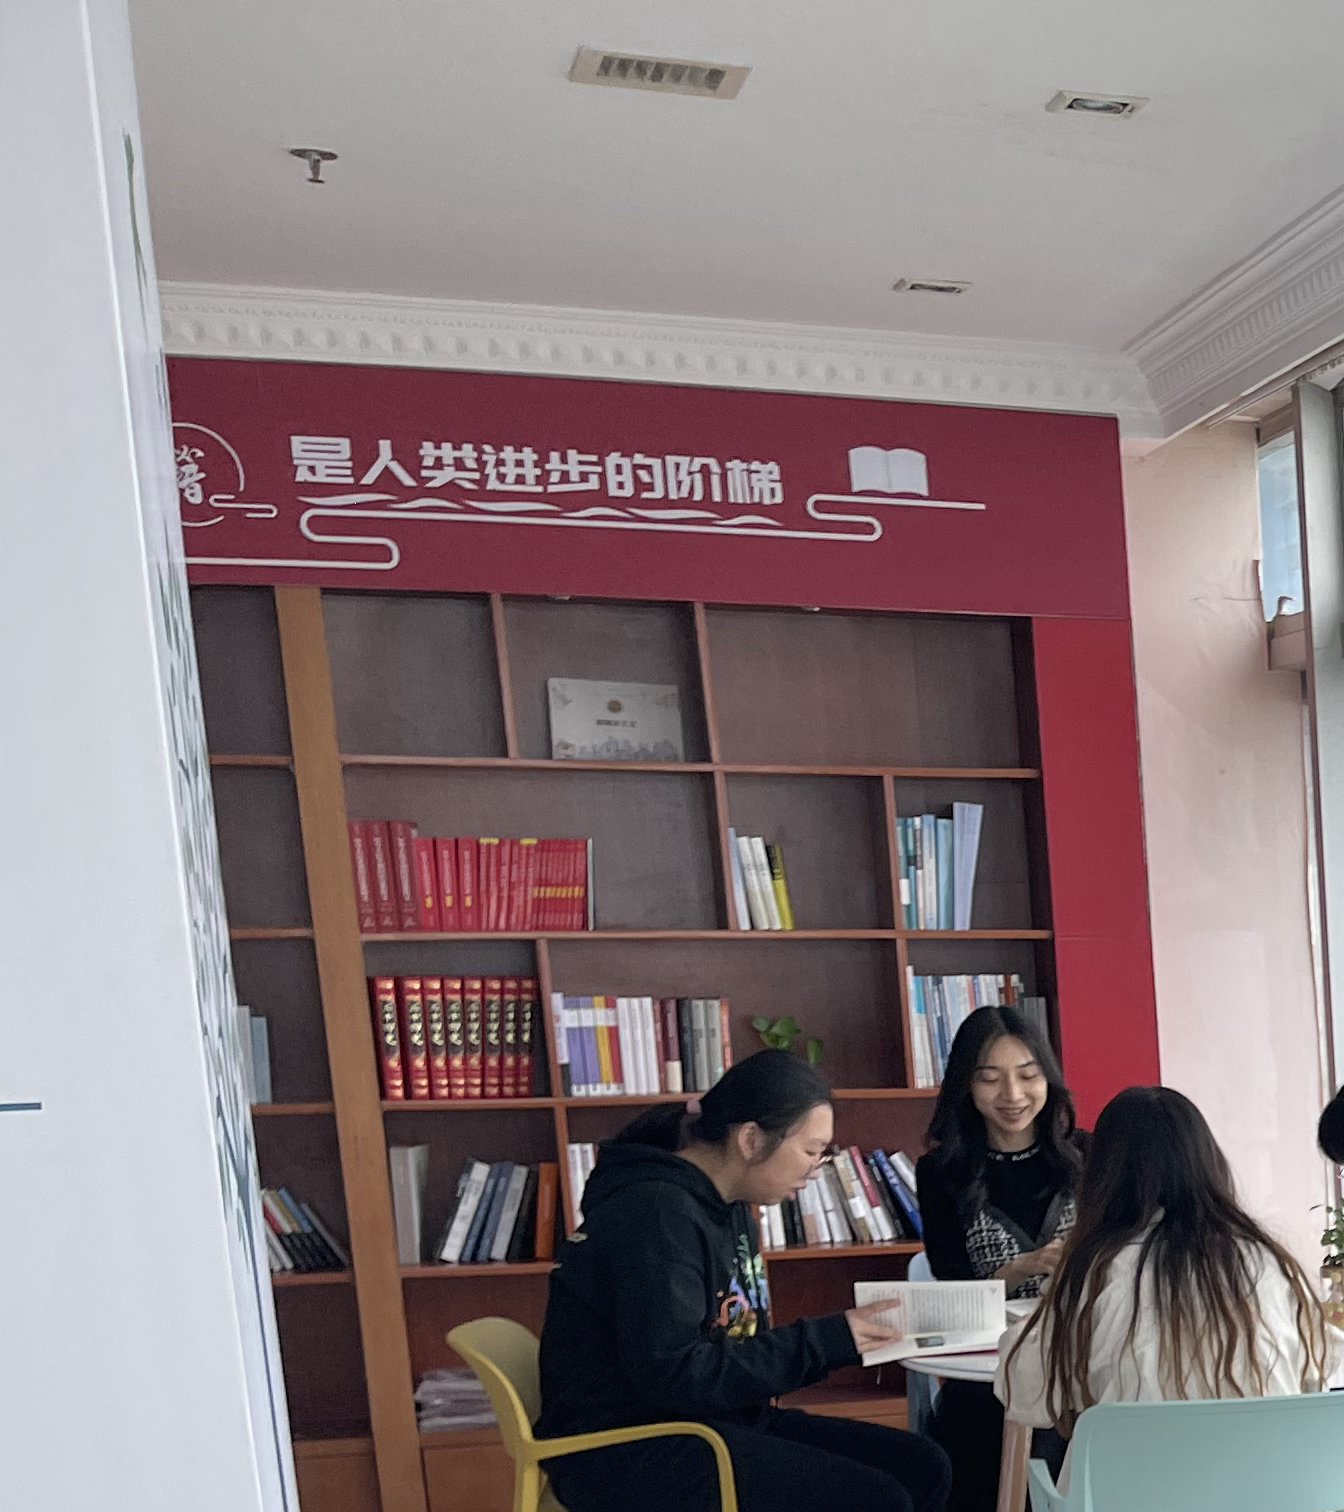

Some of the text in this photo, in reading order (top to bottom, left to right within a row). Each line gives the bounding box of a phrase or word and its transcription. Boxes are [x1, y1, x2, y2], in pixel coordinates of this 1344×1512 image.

[290, 435, 784, 505] 是人类进步的阶梯
